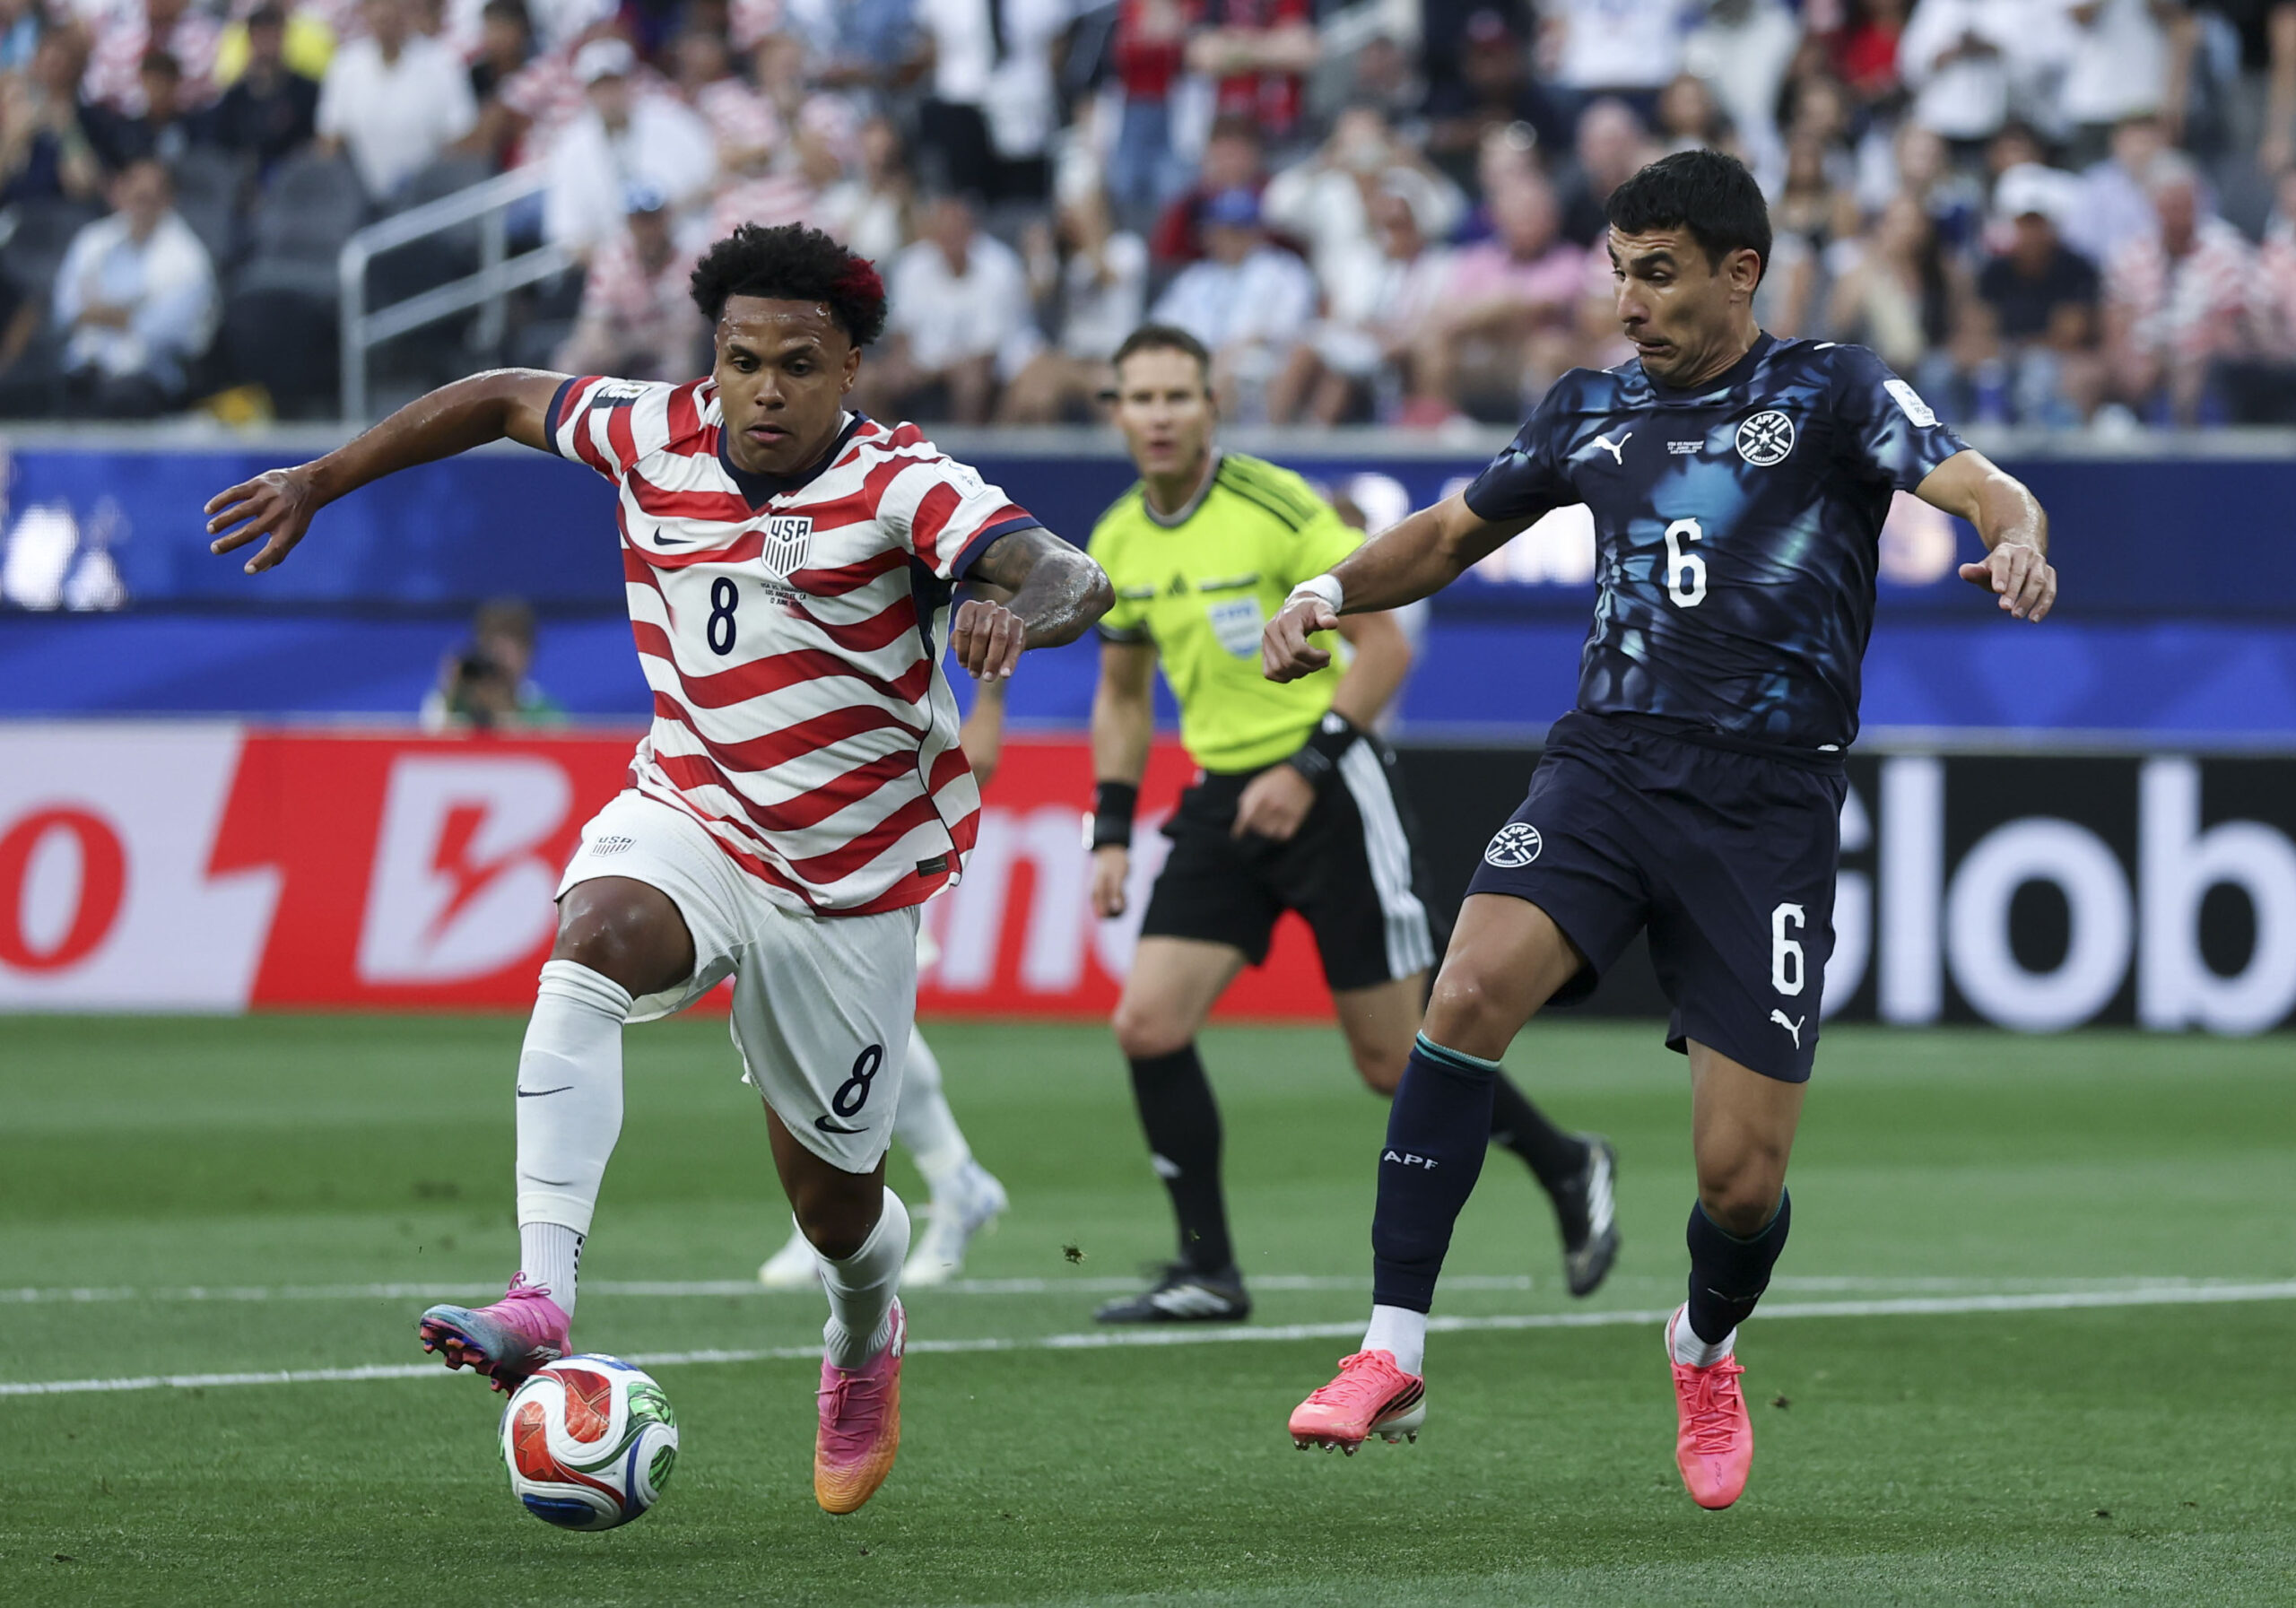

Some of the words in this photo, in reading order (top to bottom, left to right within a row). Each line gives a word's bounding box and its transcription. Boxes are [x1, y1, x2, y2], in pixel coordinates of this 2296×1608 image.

[1755, 414, 1775, 425] APF
[770, 520, 809, 543] USA
[1665, 517, 1707, 608] 6
[707, 577, 739, 656] 8
[598, 836, 632, 844] USA
[1508, 827, 1528, 835] APF
[1771, 902, 1805, 996] 6
[832, 1044, 883, 1117] 8
[1384, 1150, 1439, 1170] APF
